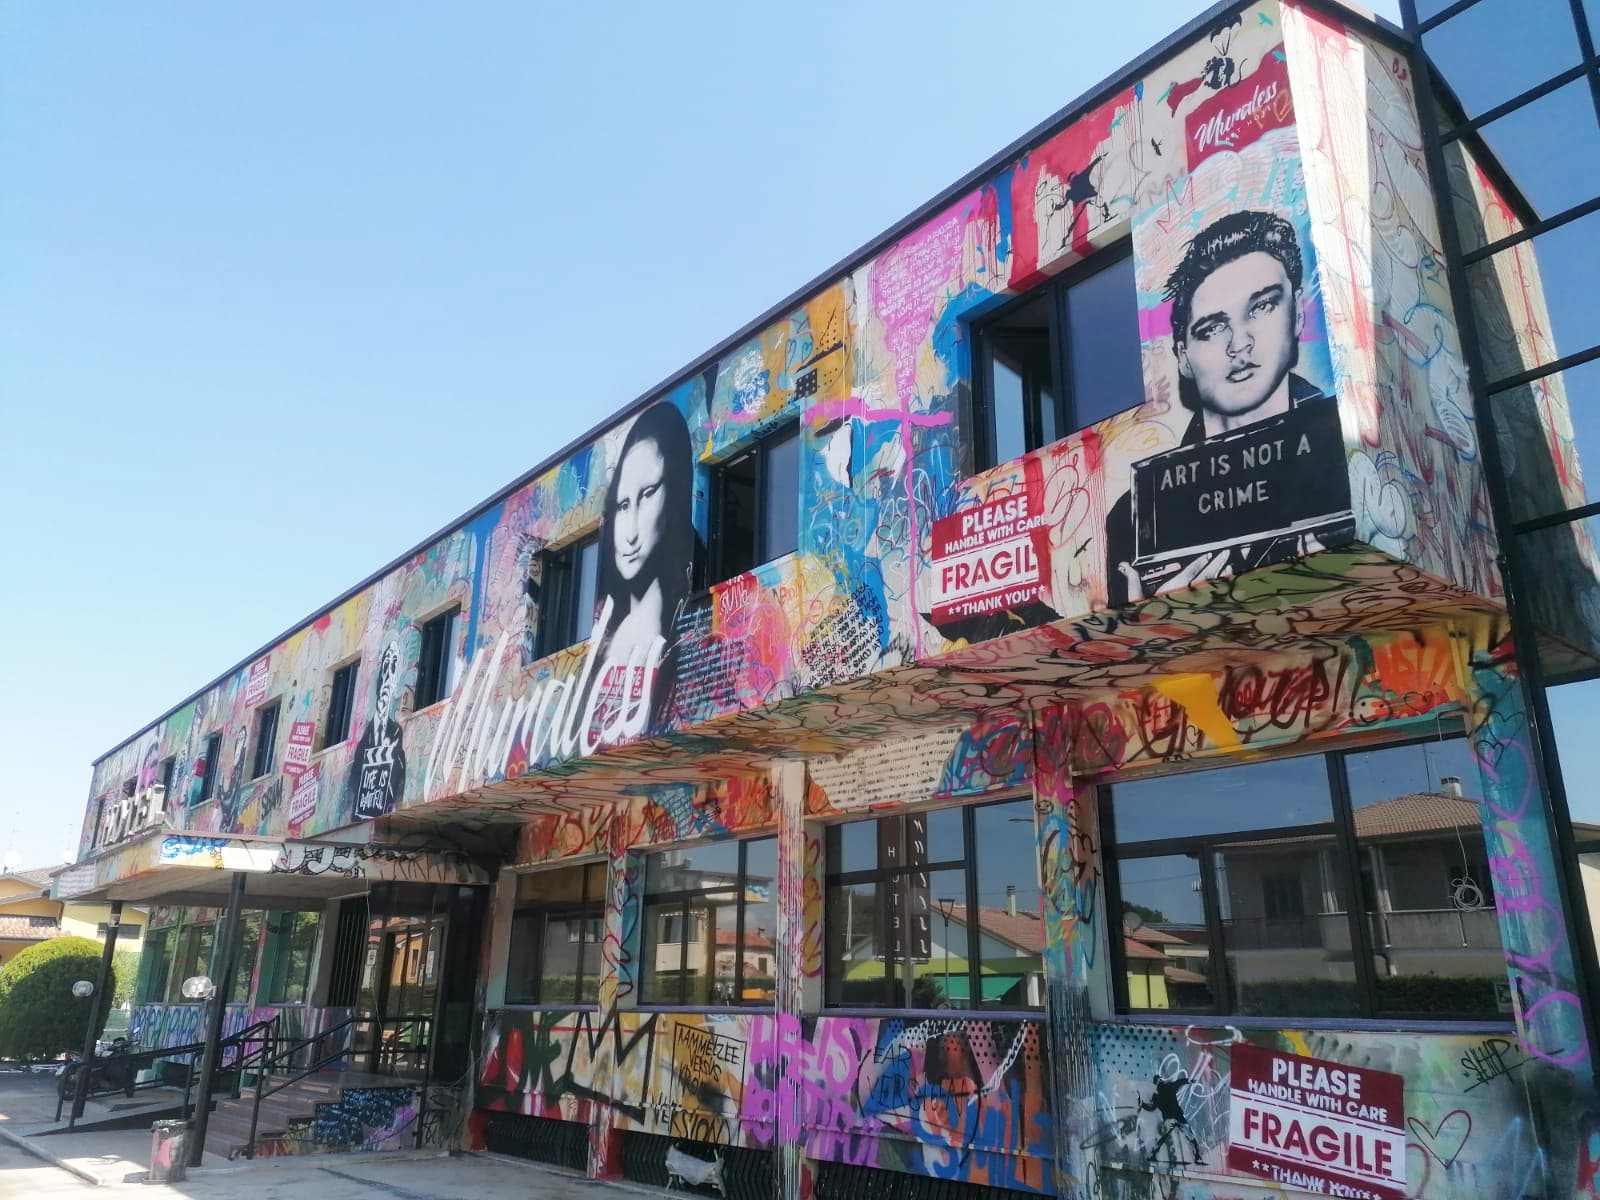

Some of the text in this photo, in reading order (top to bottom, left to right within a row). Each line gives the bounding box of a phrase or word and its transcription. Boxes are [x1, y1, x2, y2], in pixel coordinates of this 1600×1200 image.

[1161, 433, 1311, 491] ART IS NOT A
[963, 496, 1028, 536] PLEASE
[1198, 480, 1269, 514] CRIME
[945, 532, 985, 555] HANDLE
[987, 524, 1013, 542] WITH
[1272, 1057, 1361, 1099] PLEASE
[1248, 1078, 1388, 1123] HANDLE WITH CARE
[1243, 1107, 1393, 1177] FRAGILE
